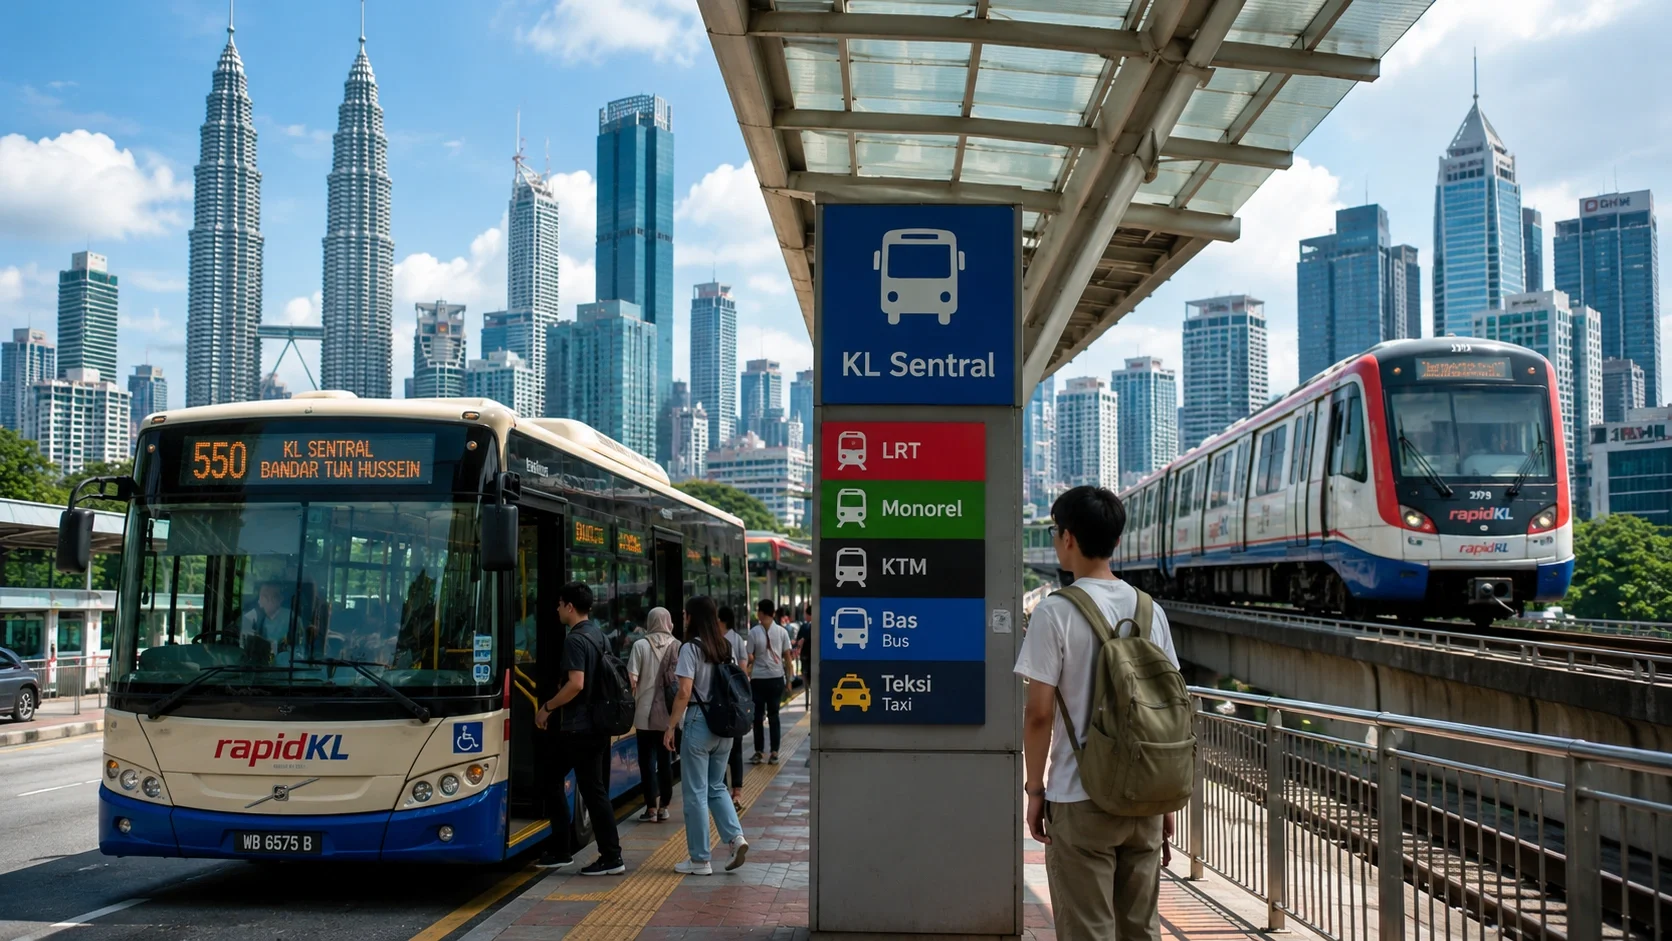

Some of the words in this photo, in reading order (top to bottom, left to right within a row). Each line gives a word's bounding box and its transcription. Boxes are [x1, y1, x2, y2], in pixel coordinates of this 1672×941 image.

[842, 351, 881, 377] KL
[889, 351, 995, 378] Sentral
[283, 440, 302, 458] KL
[308, 440, 374, 458] SENTRAL
[882, 441, 921, 459] LRT
[193, 441, 247, 479] 550
[260, 461, 319, 478] BANDAR
[325, 461, 353, 478] TUN
[358, 460, 421, 478] HUSSEIN
[882, 500, 963, 517] Monorel
[1449, 506, 1514, 524] rapidKL
[882, 558, 927, 575] KTM
[882, 611, 918, 629] Bas
[882, 634, 910, 648] Bus
[881, 674, 932, 693] Teksi
[882, 697, 912, 711] Taxi
[214, 733, 349, 768] rapidKL
[243, 834, 261, 850] WB
[265, 835, 299, 851] 6575
[303, 836, 312, 851] B
